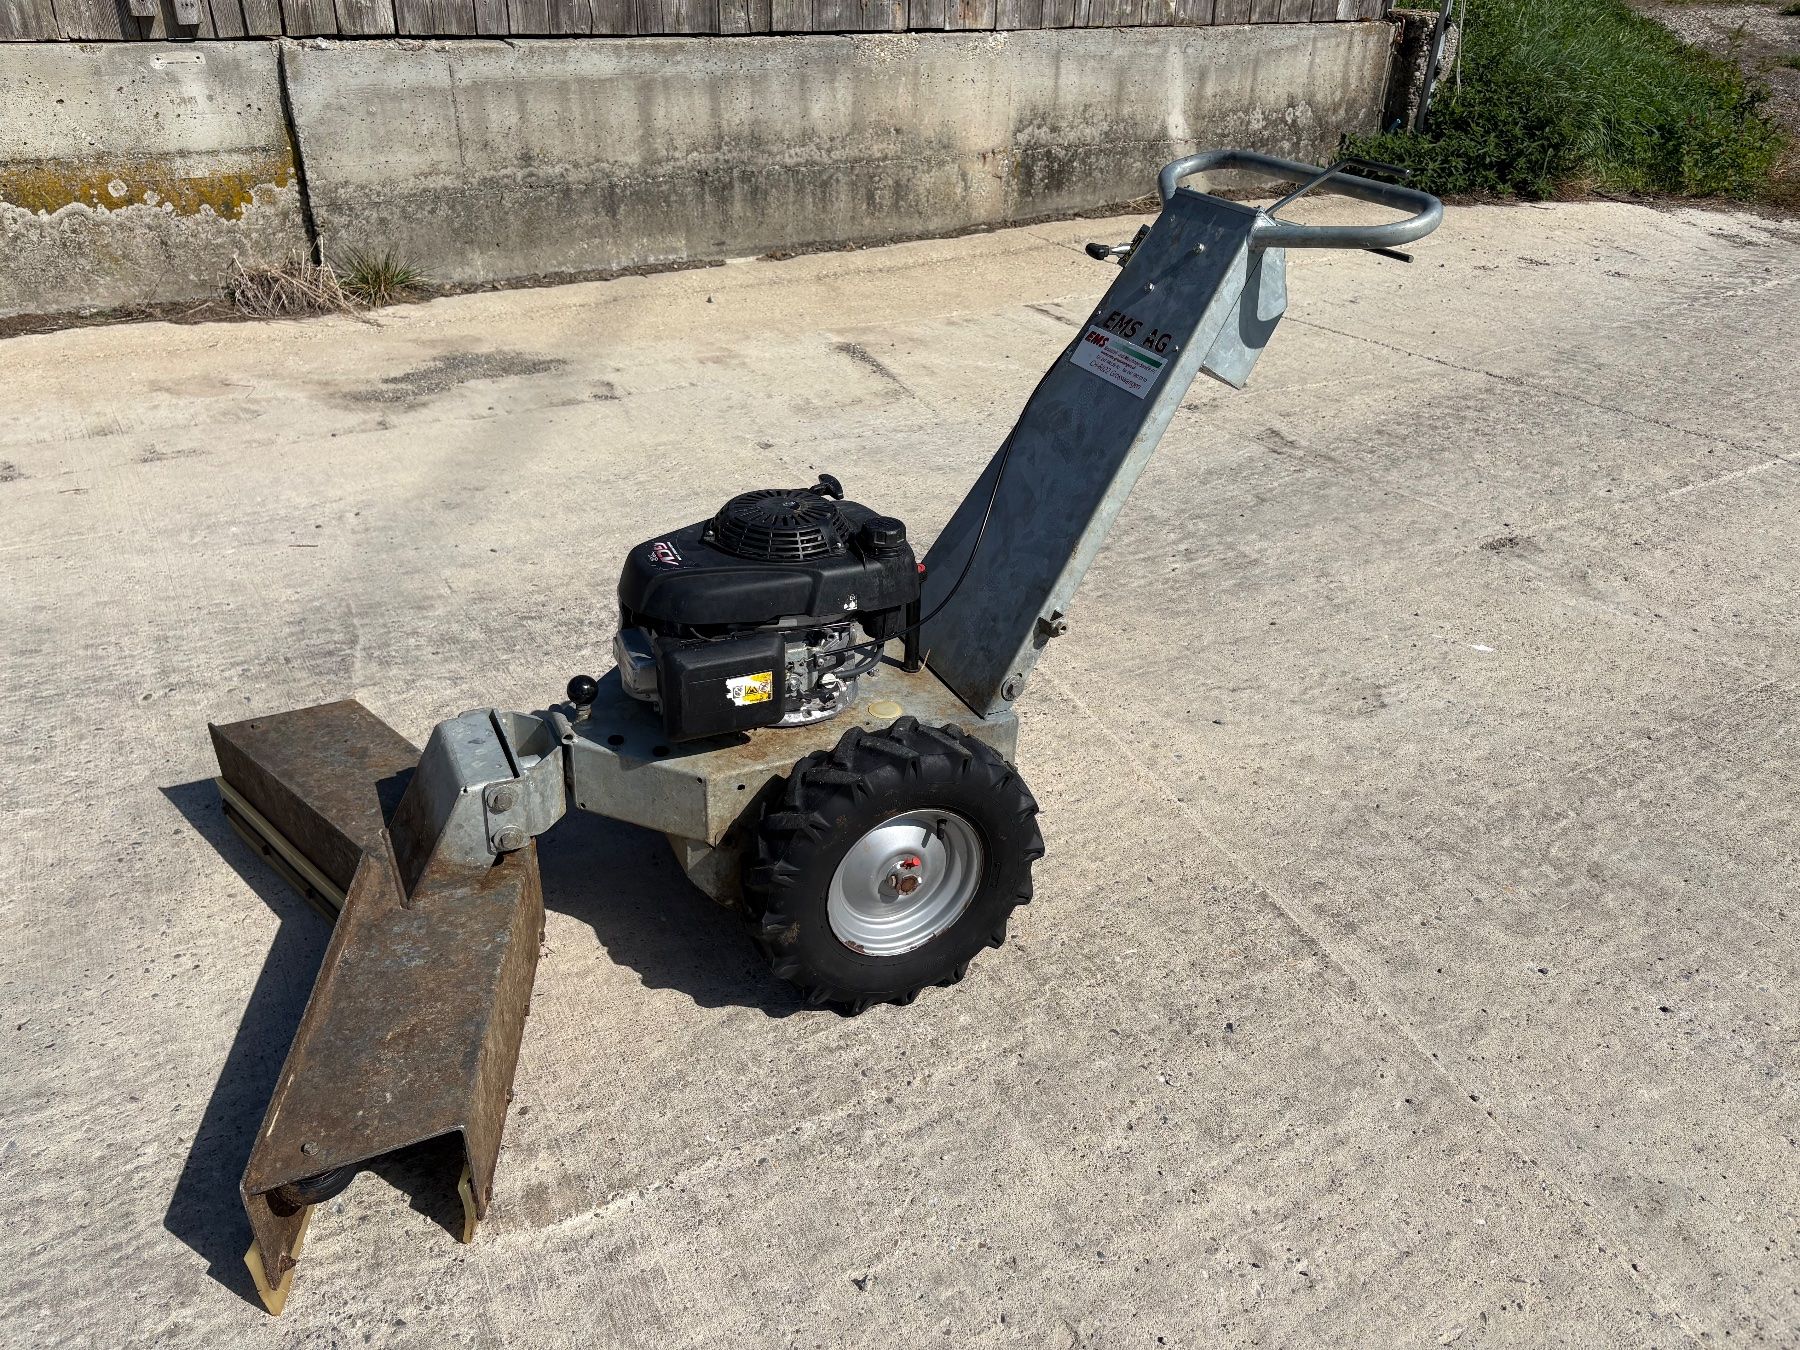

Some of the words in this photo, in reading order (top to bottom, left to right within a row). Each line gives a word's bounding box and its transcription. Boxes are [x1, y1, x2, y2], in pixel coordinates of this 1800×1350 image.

[1085, 331, 1110, 347] EMS
[1103, 310, 1143, 338] EMS
[1143, 329, 1172, 353] AG
